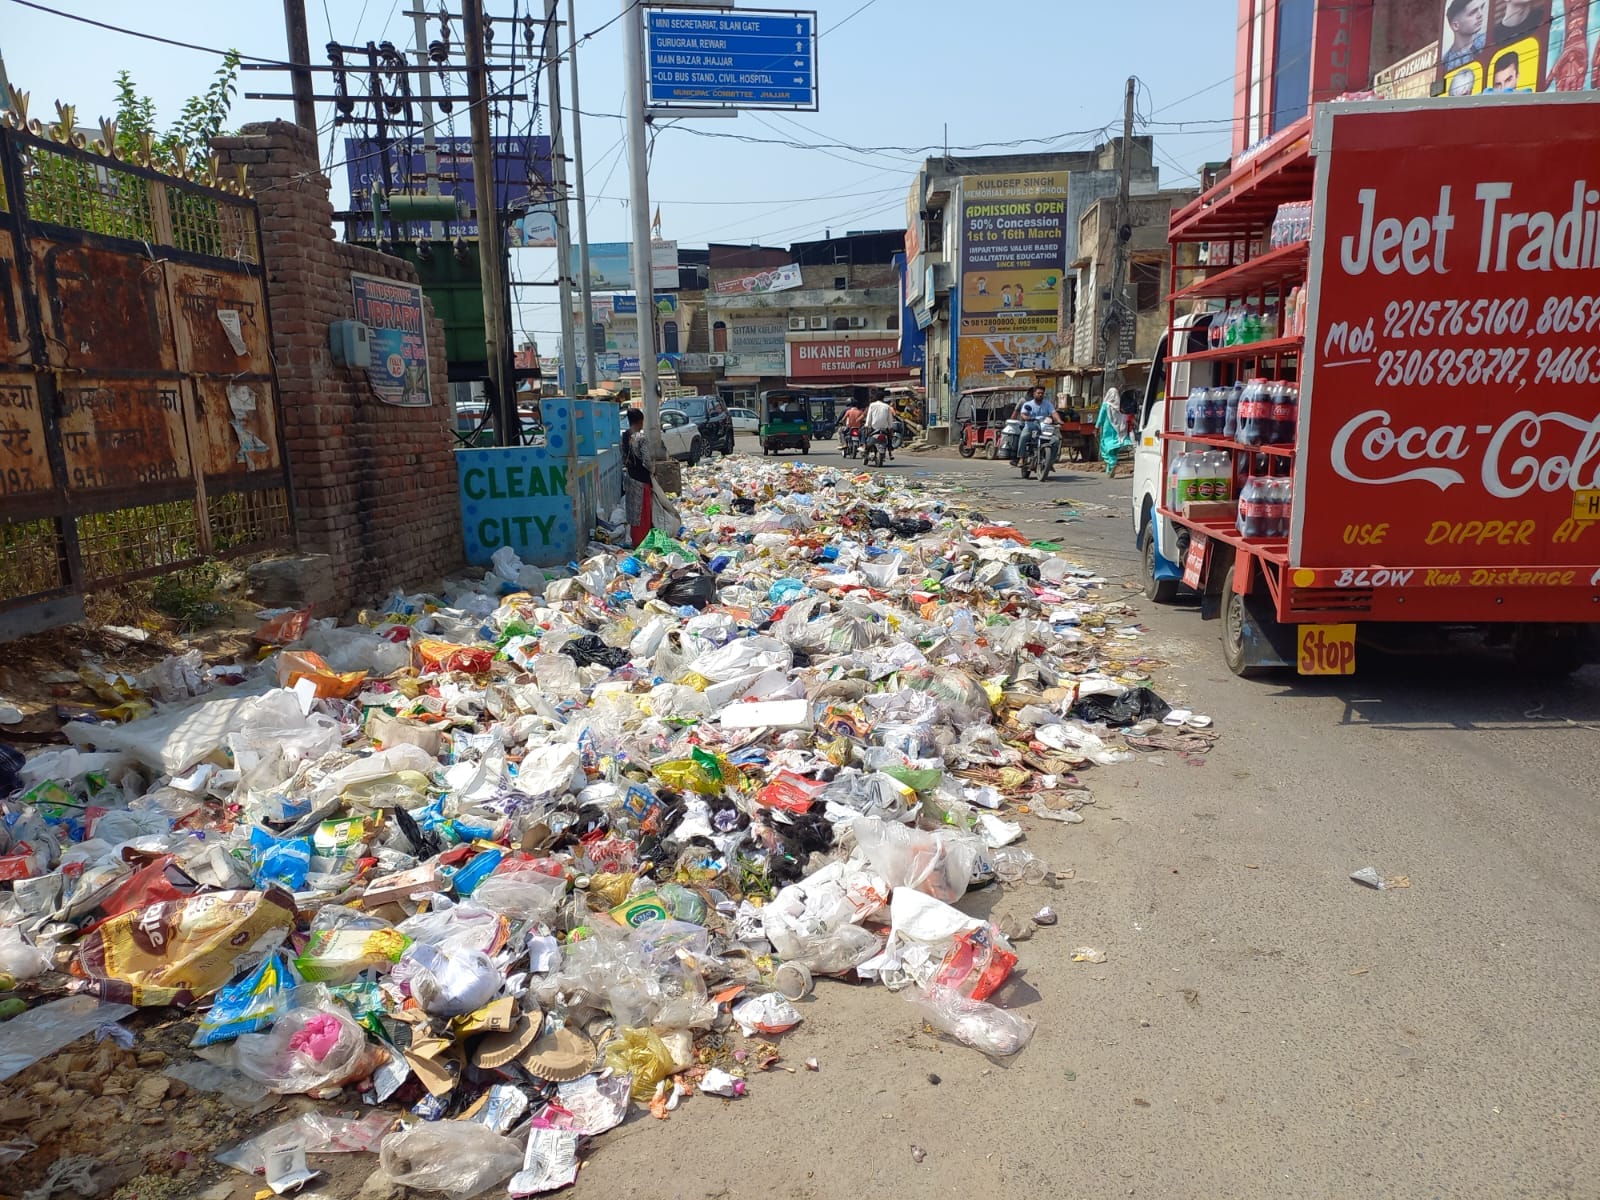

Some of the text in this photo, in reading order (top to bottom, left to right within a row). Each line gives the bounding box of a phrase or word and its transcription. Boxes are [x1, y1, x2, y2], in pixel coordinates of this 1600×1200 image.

[656, 18, 760, 31] MINI SECRETARIAT, SILANI GATE
[657, 38, 726, 49] GURUGRAM, REWARI
[657, 55, 733, 66] MAIN BAZAR JHAJJAR
[674, 72, 689, 81] BUS
[691, 73, 717, 83] STAND,
[718, 74, 736, 83] CIVIL
[740, 74, 773, 84] HOSPITAL
[977, 177, 1054, 190] KULDEEP SINGH
[964, 189, 1004, 198] MEMORIAL
[1007, 188, 1034, 196] PUBLIC
[966, 202, 1064, 218] ADMISSIONS OPEN
[970, 217, 1059, 230] 50% Concession
[1341, 180, 1600, 275] Jeet Tradi
[968, 228, 1062, 241] 1st to 16th March
[357, 297, 420, 334] LIBRARY
[800, 346, 850, 359] BIKANER
[821, 362, 871, 371] RESTAURANT
[463, 465, 569, 500] CLEAN
[477, 514, 556, 548] CITY
[1343, 518, 1595, 545] USE DIPPER AT
[1334, 568, 1415, 588] BLOW
[1469, 568, 1576, 586] Distance
[1301, 630, 1354, 672] Stop
